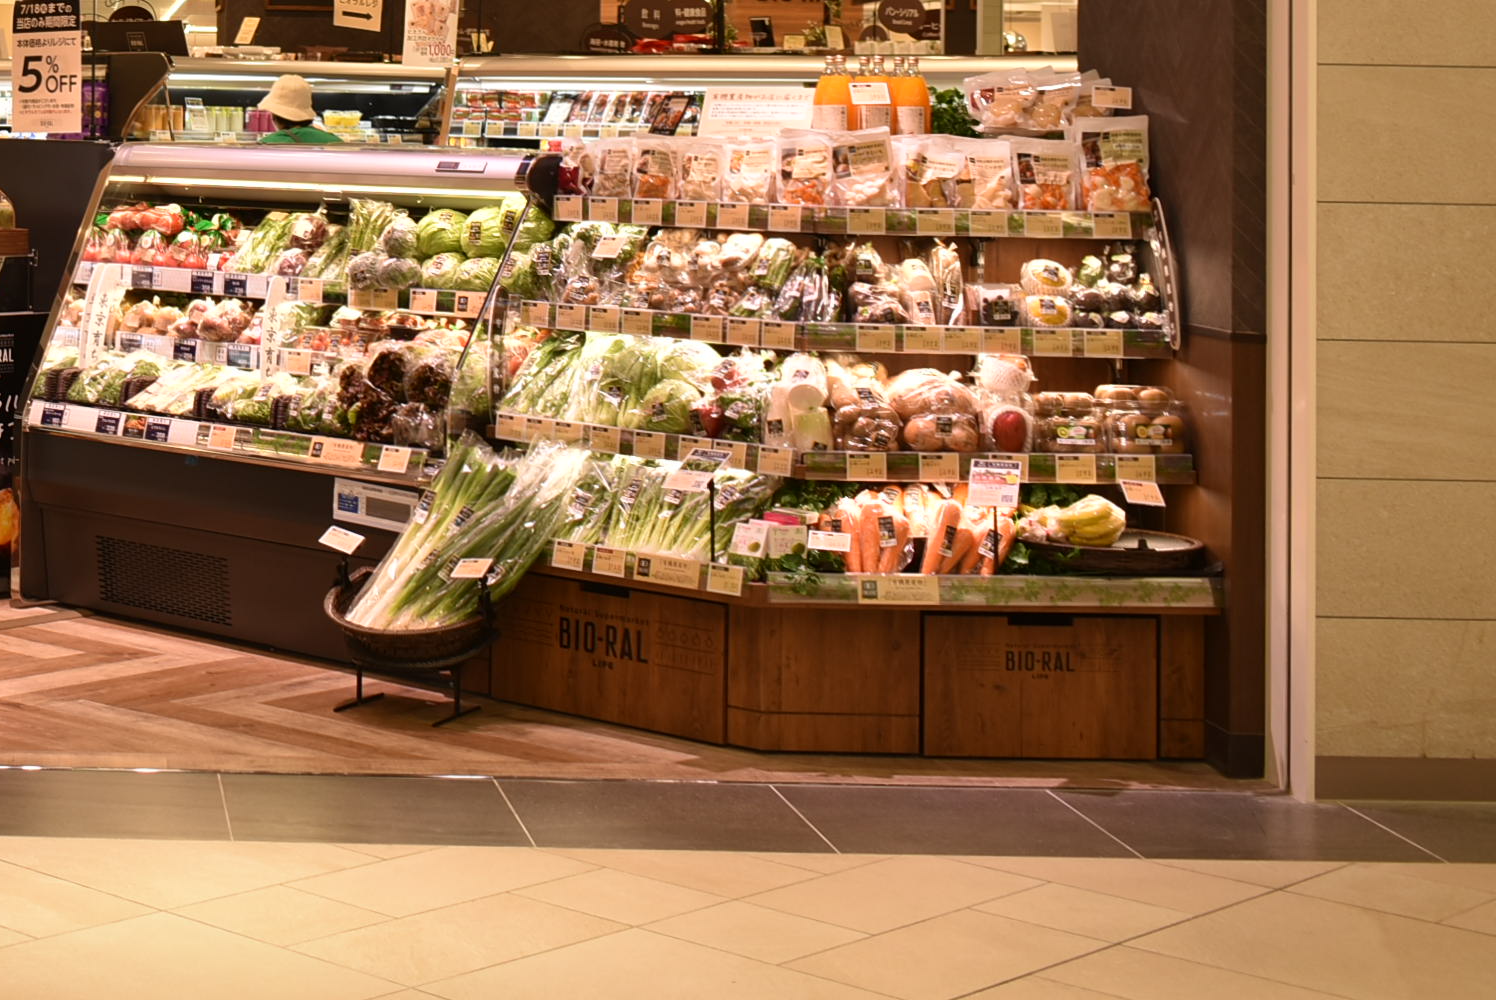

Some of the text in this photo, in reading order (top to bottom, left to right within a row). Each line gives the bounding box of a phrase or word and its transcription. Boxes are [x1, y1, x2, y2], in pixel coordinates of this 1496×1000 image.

[45, 75, 77, 93] OFF
[559, 616, 649, 664] BIO-RAL
[1005, 651, 1075, 672] BIO-RAL
